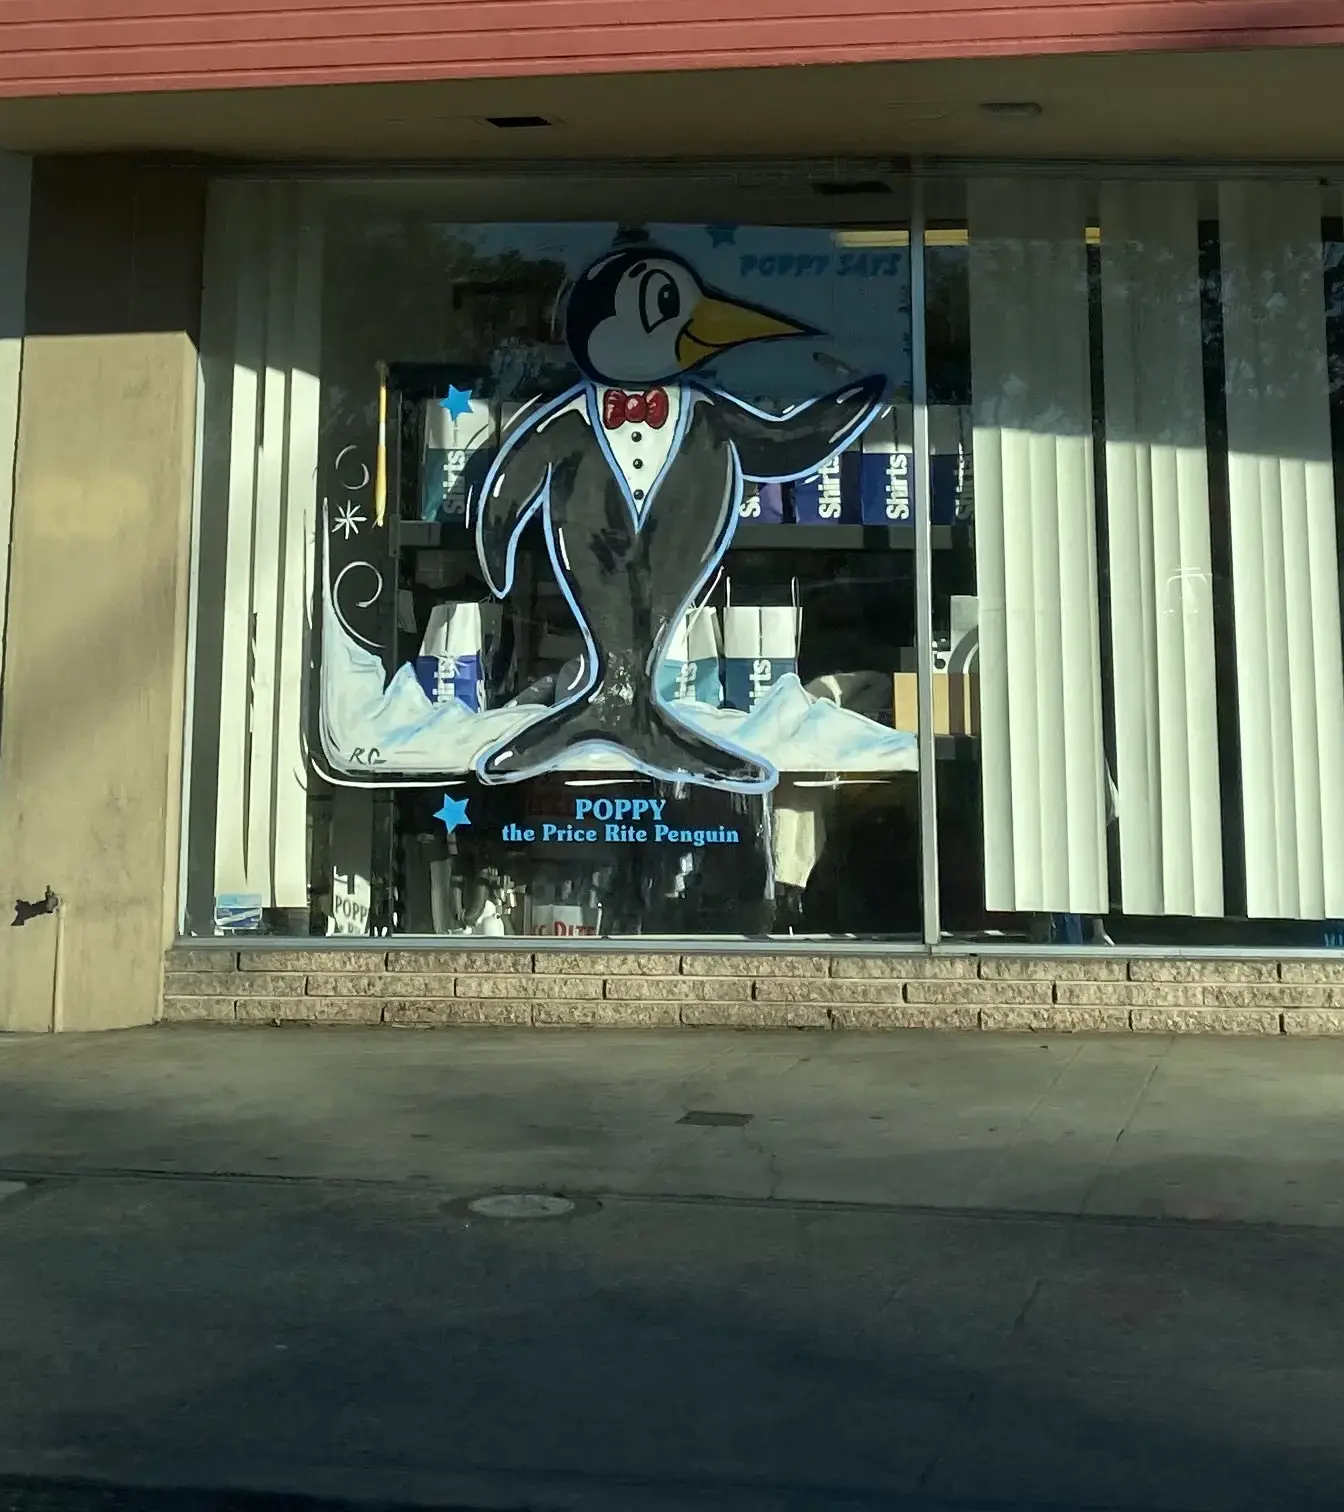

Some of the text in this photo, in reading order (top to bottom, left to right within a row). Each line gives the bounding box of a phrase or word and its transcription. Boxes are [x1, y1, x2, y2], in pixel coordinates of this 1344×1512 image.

[739, 252, 902, 278] POPPY SAYS
[818, 454, 842, 520] Shirts
[886, 453, 911, 521] Shirts
[575, 798, 667, 821] POPPY
[502, 823, 740, 847] the Price Rite Penguin
